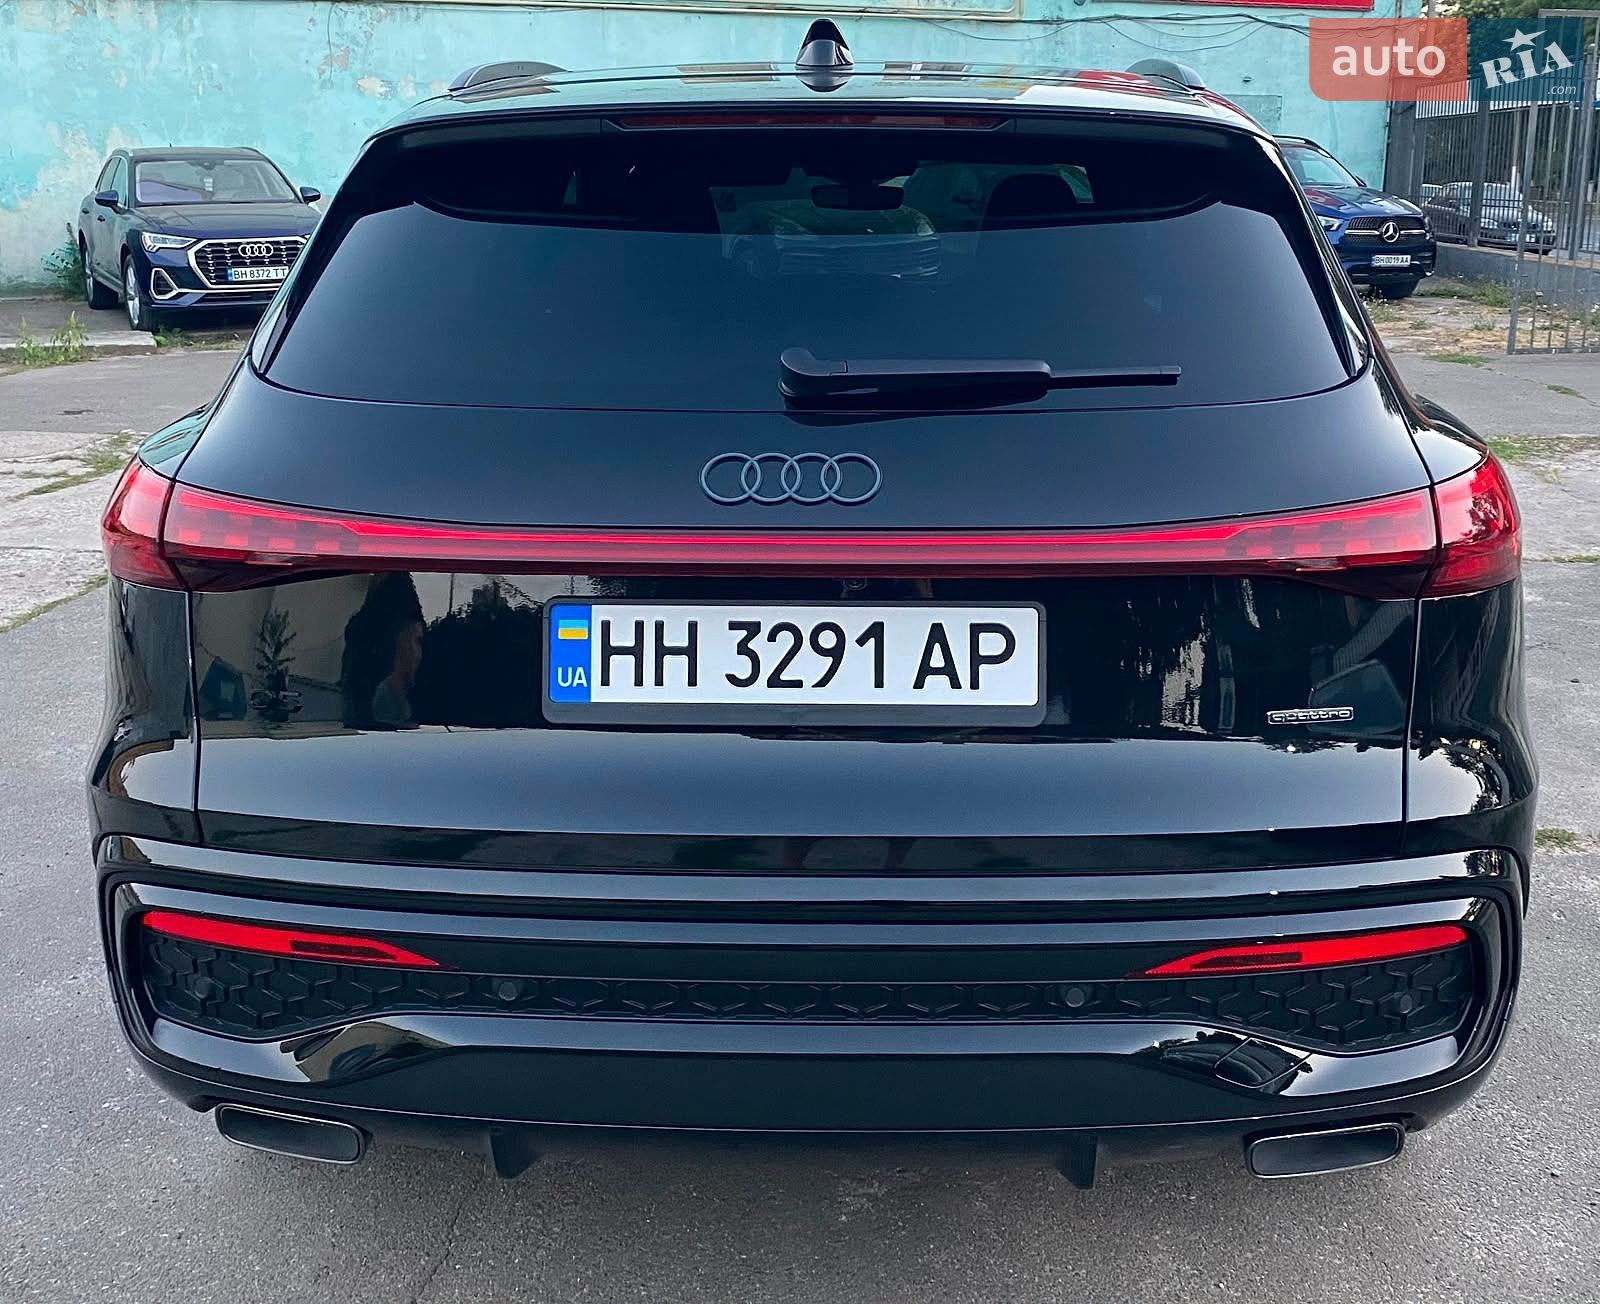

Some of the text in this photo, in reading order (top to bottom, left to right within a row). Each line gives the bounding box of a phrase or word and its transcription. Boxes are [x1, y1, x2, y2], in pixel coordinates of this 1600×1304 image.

[233, 268, 287, 279] BH 8372 TT
[600, 620, 1017, 690] HH 3291 AP
[557, 667, 588, 688] UA
[1272, 710, 1351, 722] quattro
